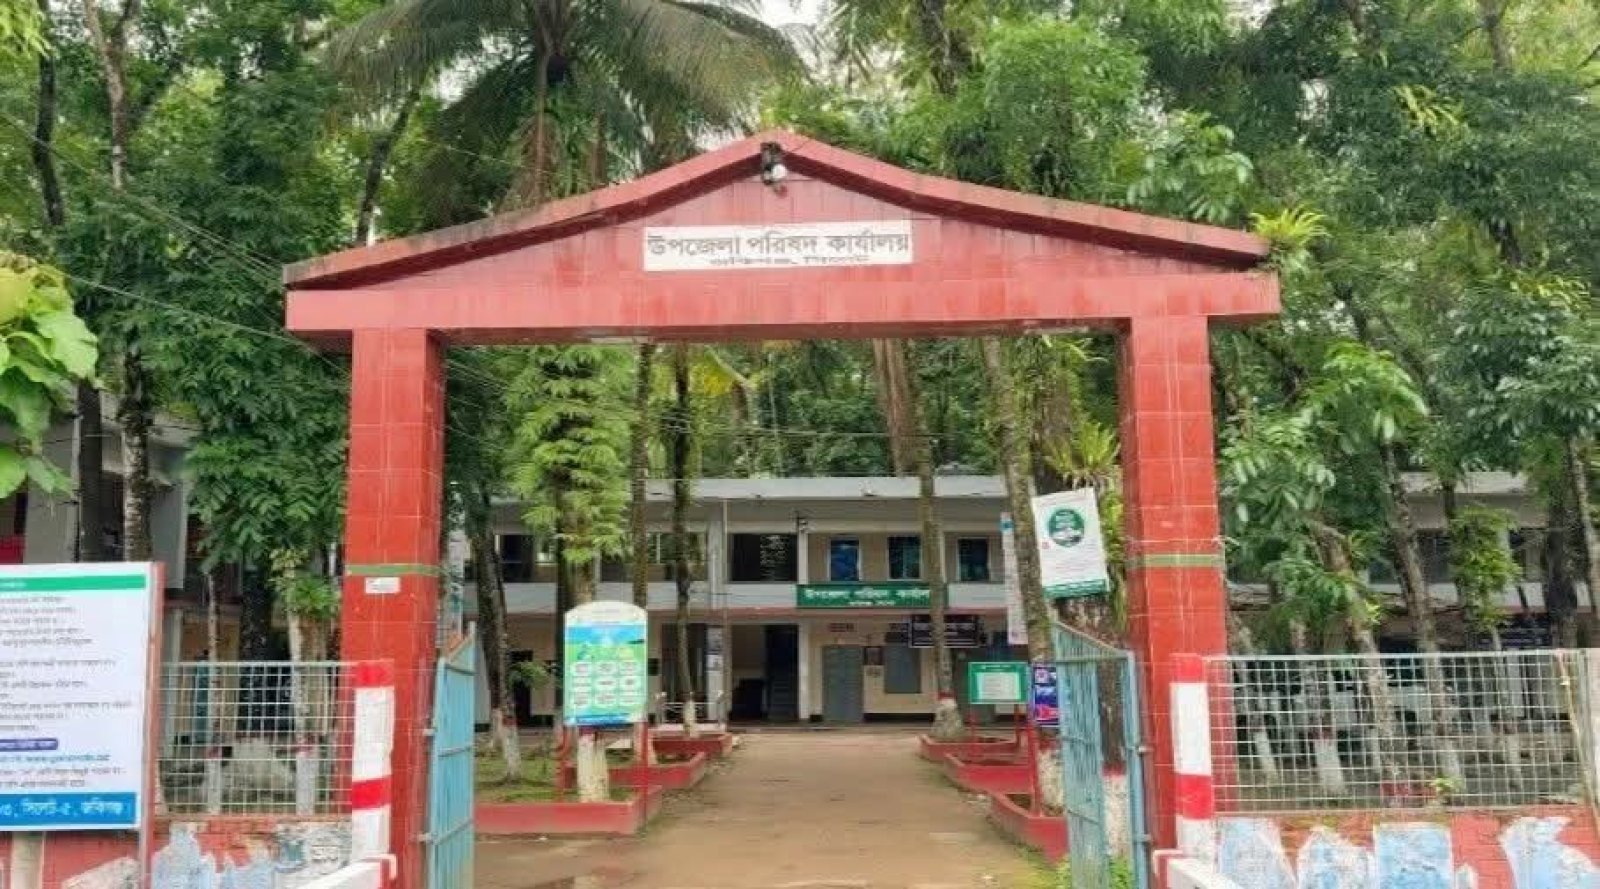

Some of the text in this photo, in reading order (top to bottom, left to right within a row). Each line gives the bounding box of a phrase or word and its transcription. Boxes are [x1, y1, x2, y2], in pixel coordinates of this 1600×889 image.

[647, 229, 908, 255] উপজেলা পরিষদ কার্যালয়
